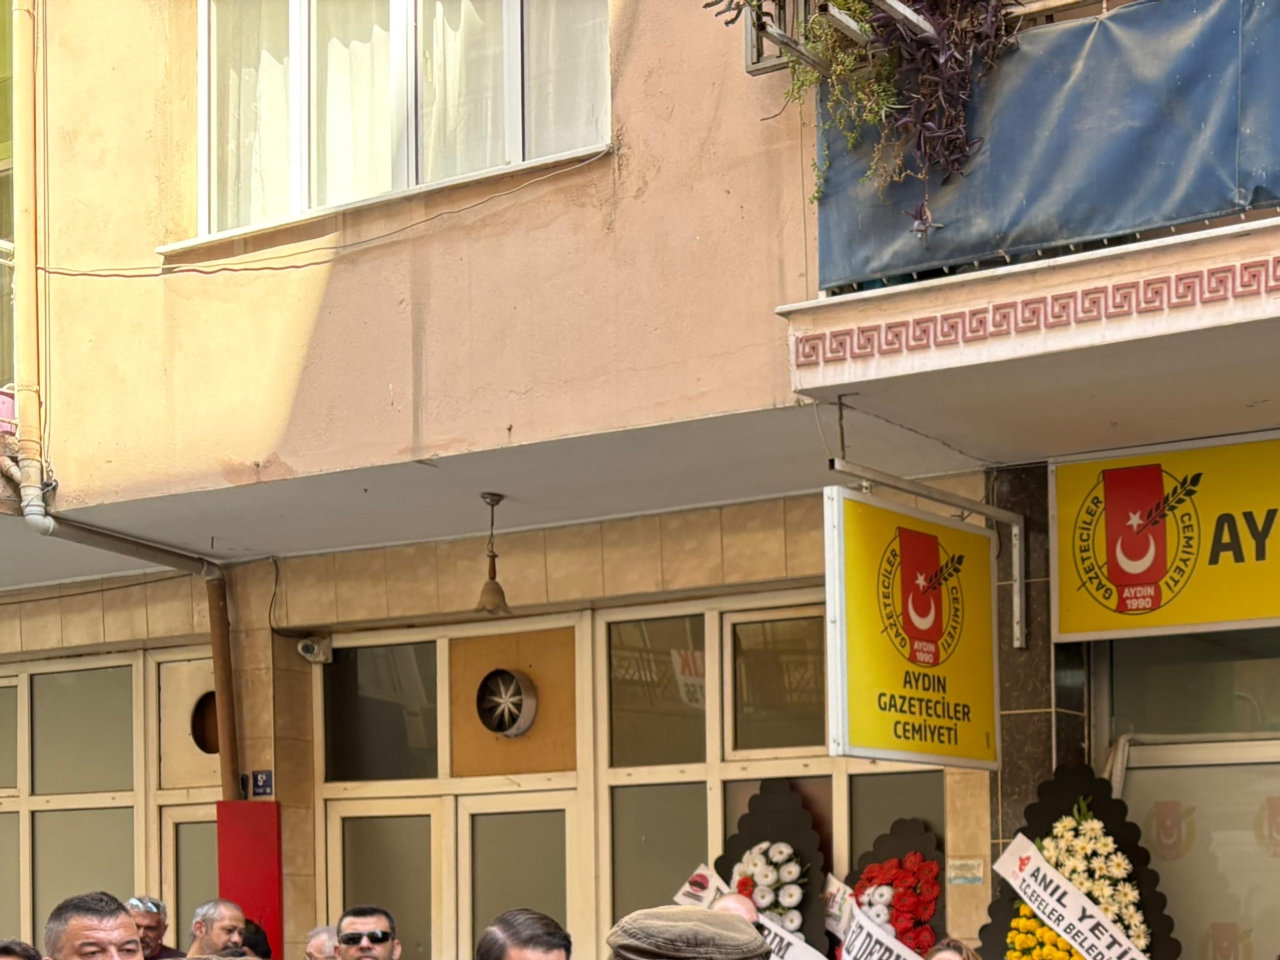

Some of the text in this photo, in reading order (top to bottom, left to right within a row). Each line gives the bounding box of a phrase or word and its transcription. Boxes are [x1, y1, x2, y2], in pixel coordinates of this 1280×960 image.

[1078, 496, 1114, 601] GAZETECİLER
[1122, 586, 1155, 598] AYDIN
[1126, 598, 1152, 610] 1990
[913, 640, 936, 653] AYDIN
[903, 670, 947, 694] AYDIN
[877, 691, 972, 723] GAZETECİLER
[893, 719, 959, 746] CEMİYETİ
[1029, 866, 1069, 909] ANIL
